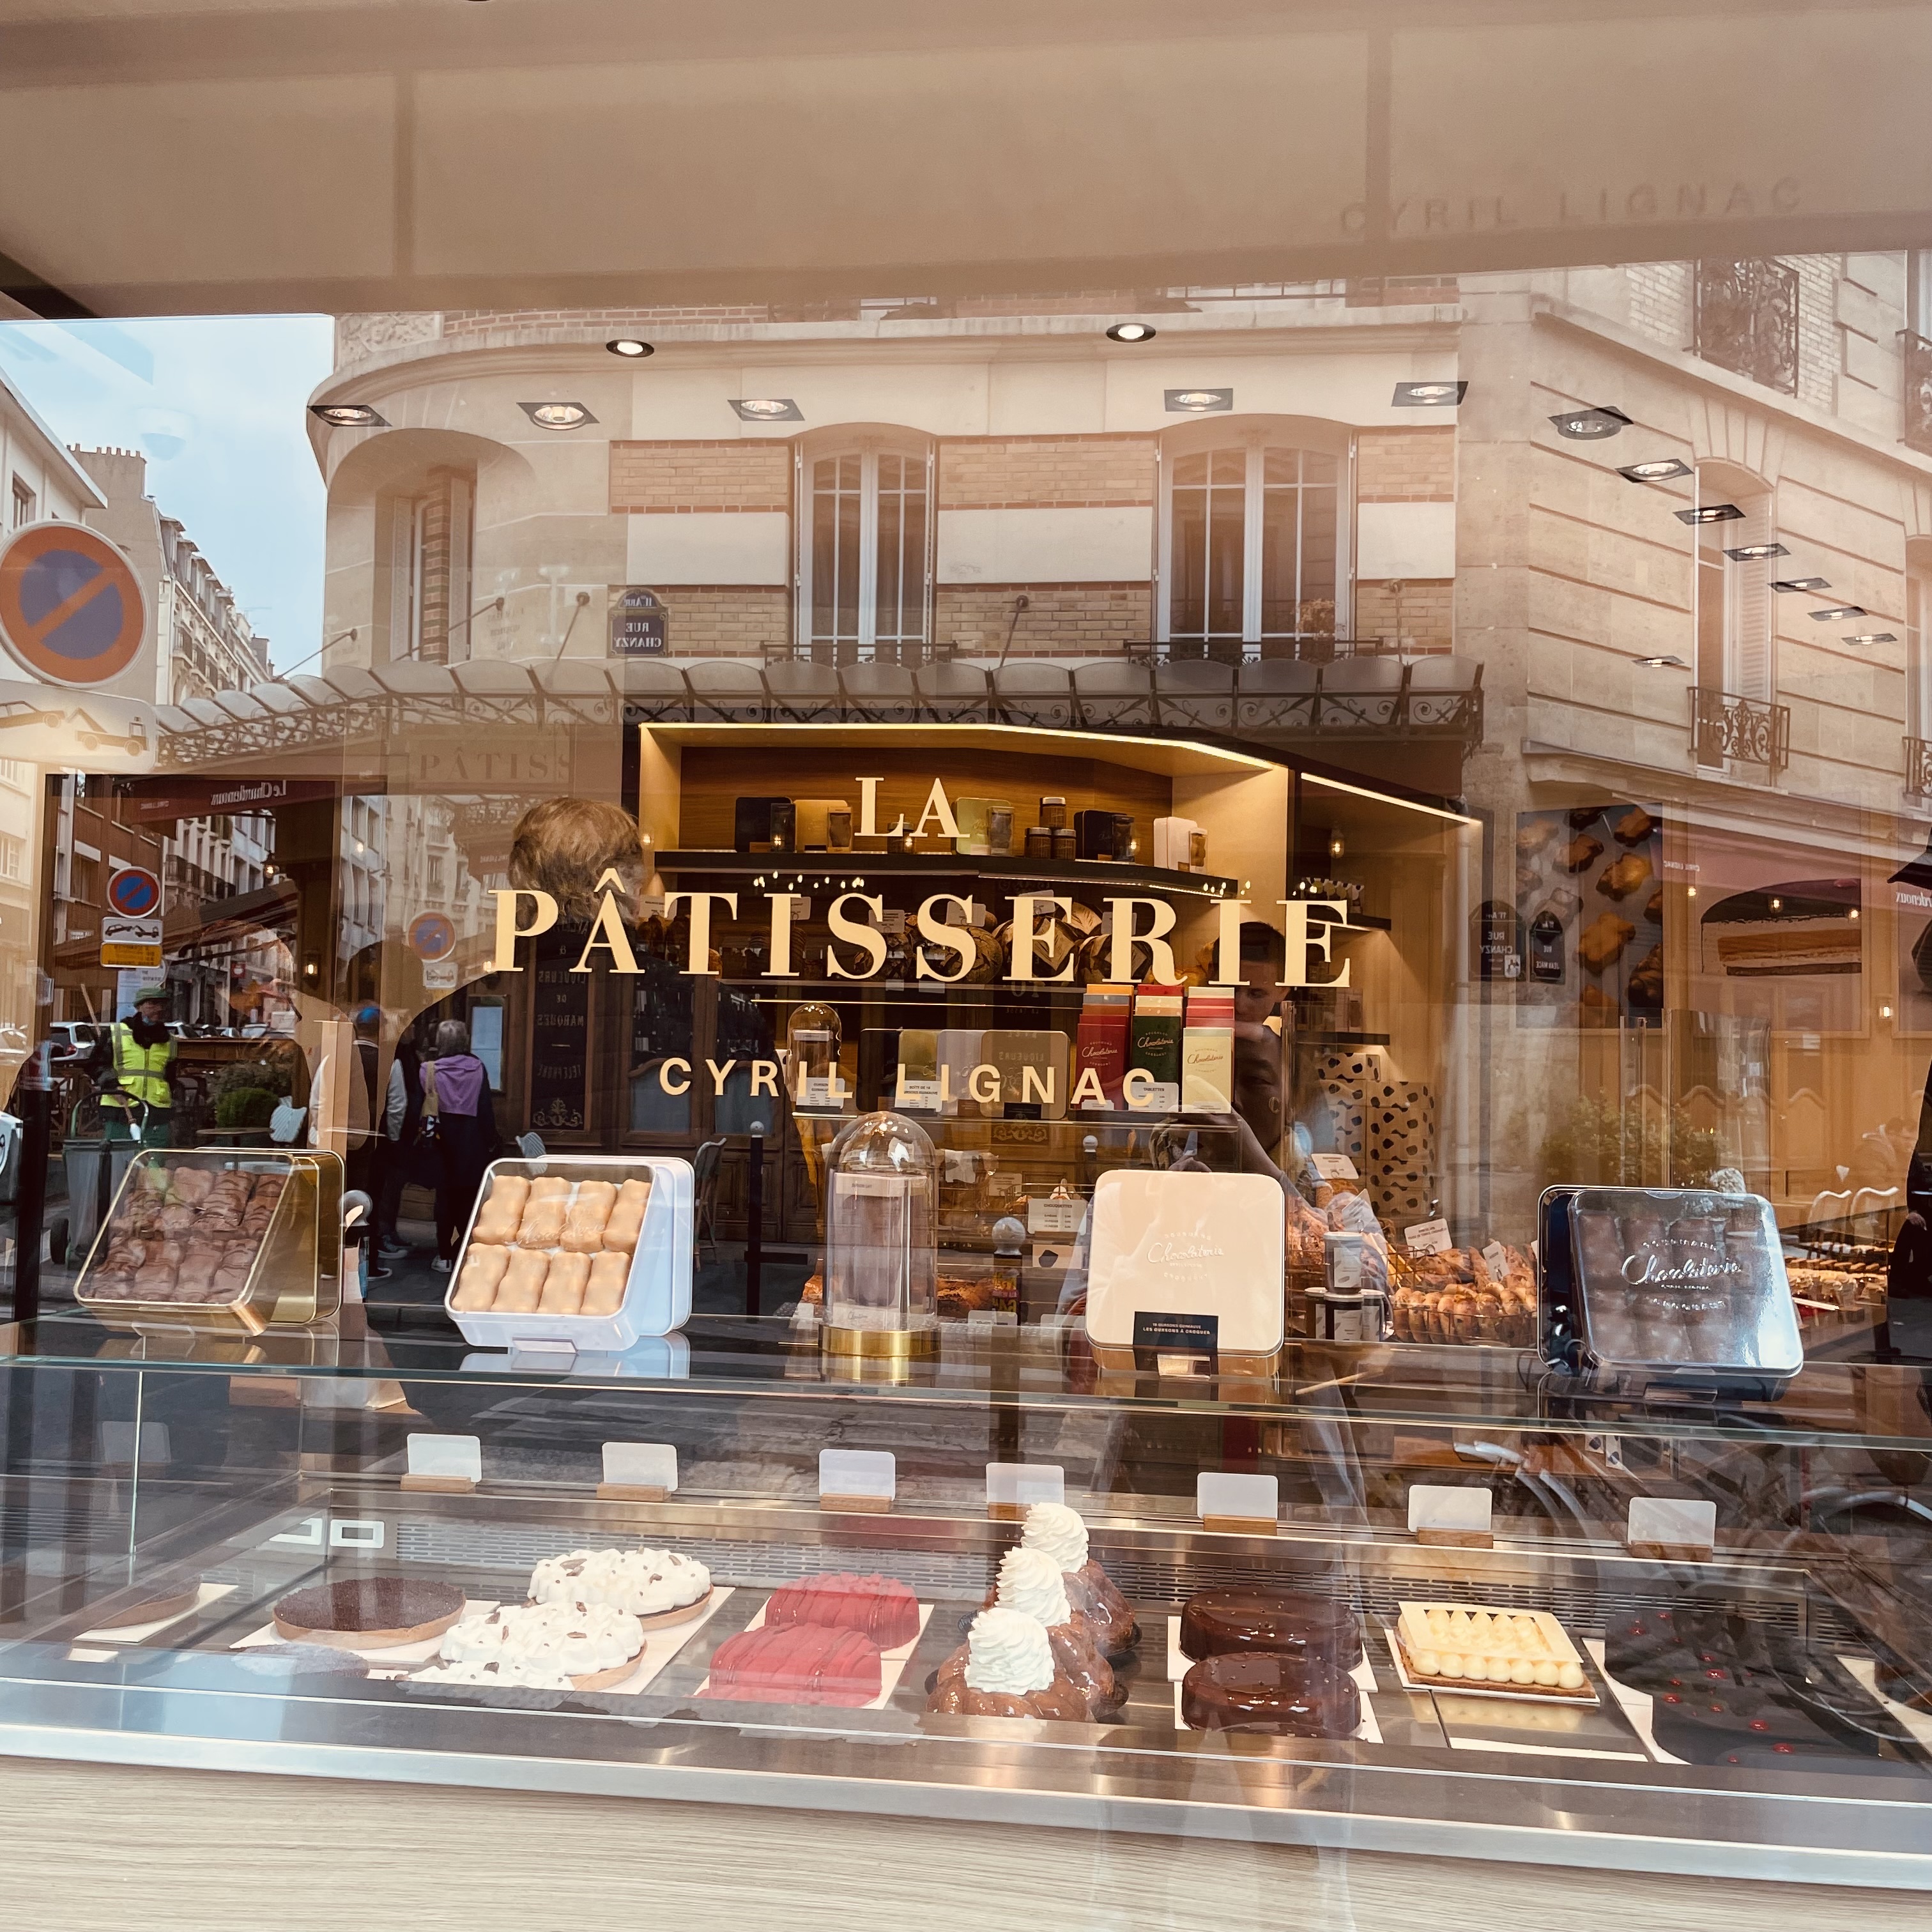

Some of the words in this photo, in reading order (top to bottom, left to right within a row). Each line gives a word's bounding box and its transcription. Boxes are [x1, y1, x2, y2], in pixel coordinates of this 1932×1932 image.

[854, 777, 970, 838] LA
[488, 868, 1351, 988] PÂTISSERIE
[659, 1057, 854, 1100] CYRIL
[896, 1061, 1156, 1107] LIGNAC
[1147, 1242, 1224, 1263] Chocolaterie
